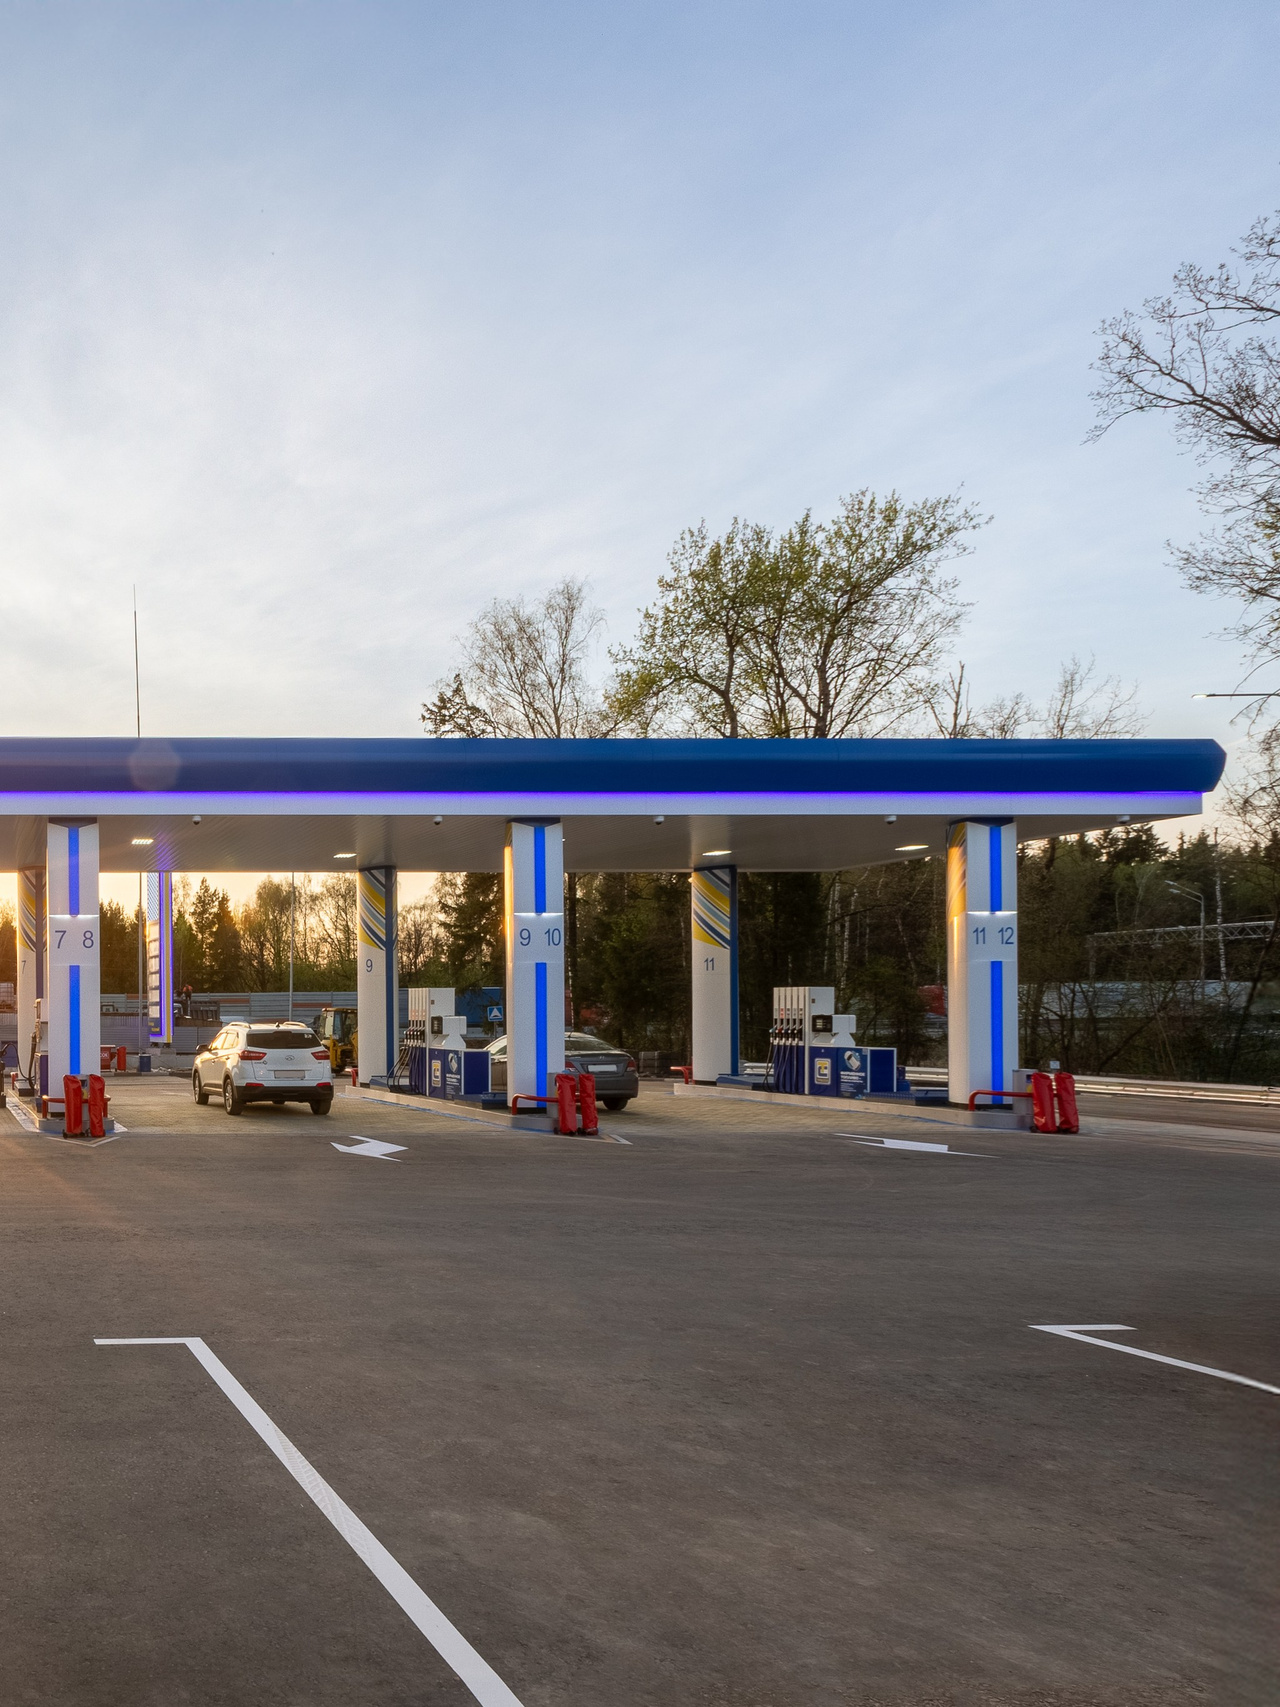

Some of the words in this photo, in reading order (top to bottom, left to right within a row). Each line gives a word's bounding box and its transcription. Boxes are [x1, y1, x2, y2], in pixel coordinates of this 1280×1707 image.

[55, 931, 66, 948] 7
[83, 931, 94, 948] 8
[520, 929, 530, 947] 9
[545, 928, 561, 946] 10
[973, 927, 985, 945] 11
[997, 927, 1014, 945] 12
[21, 960, 26, 974] 7
[365, 959, 373, 973] 9
[704, 958, 715, 971] 11
